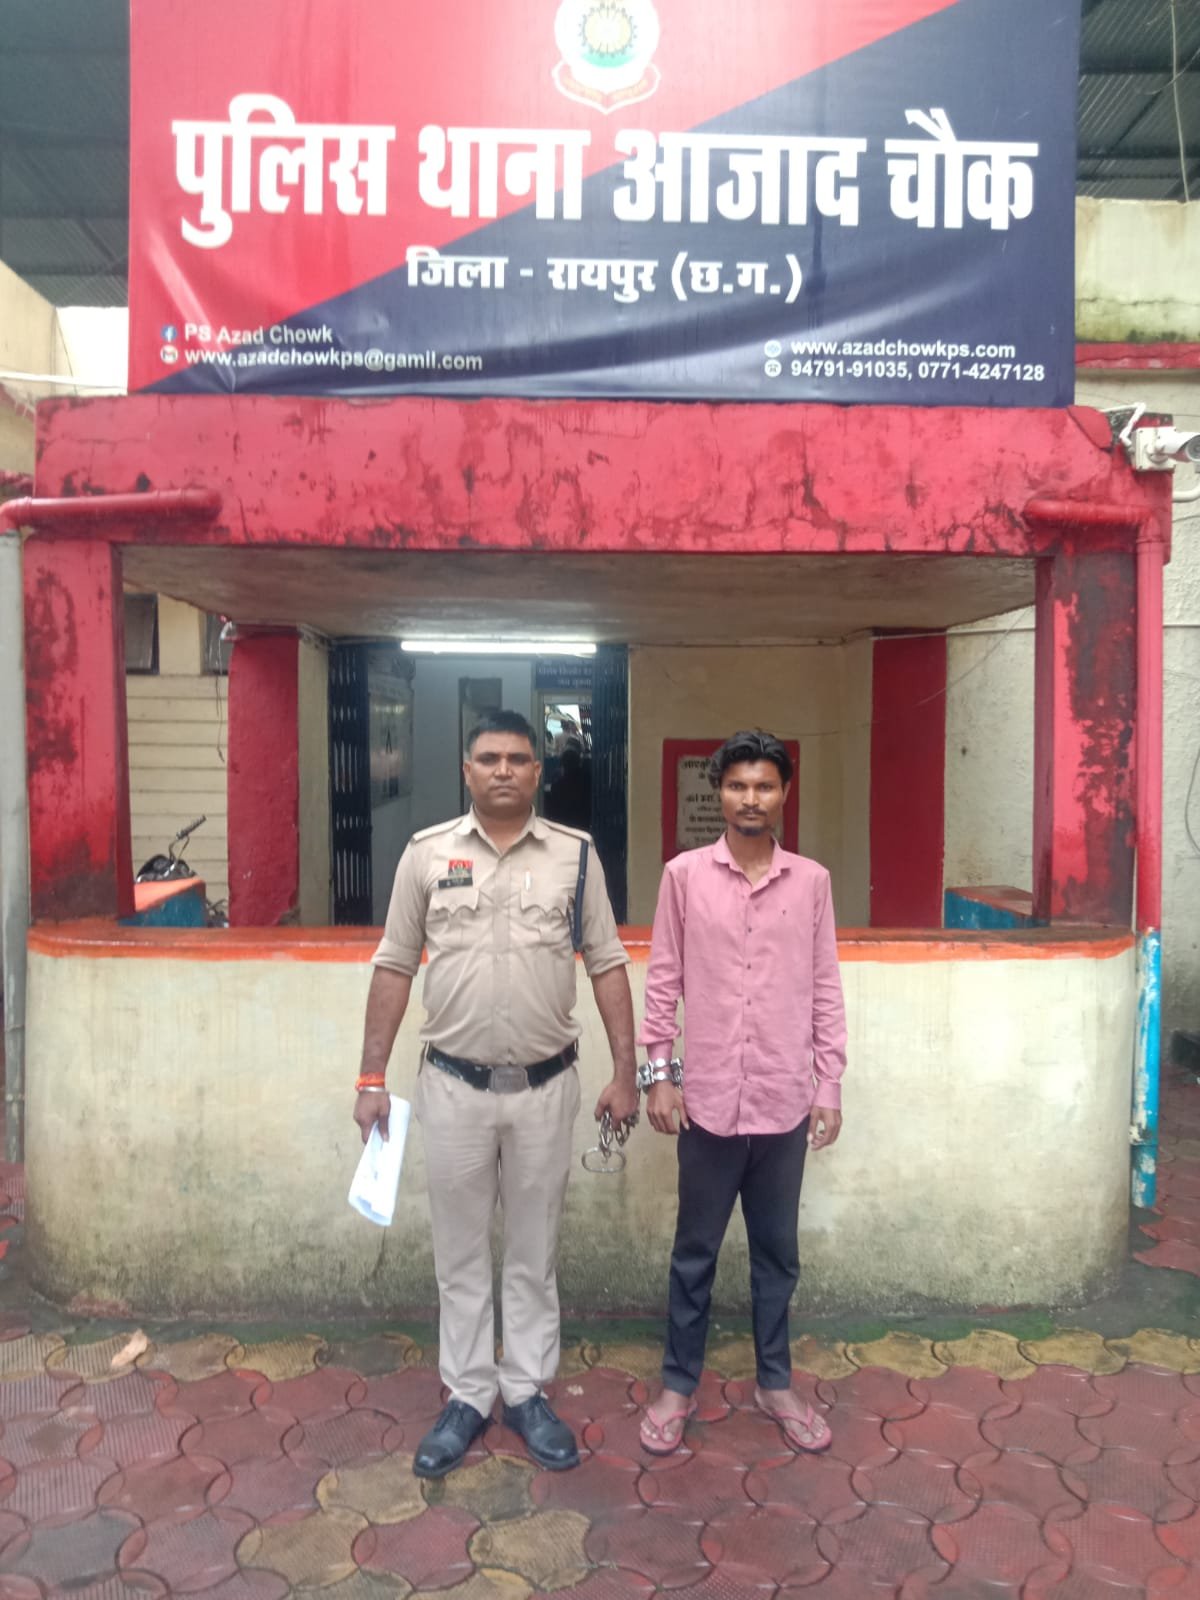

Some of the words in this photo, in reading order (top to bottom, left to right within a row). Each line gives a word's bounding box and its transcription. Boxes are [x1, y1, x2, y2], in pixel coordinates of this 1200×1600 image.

[171, 93, 396, 248] पुलिस
[418, 125, 591, 220] थाना
[613, 129, 867, 226] आजाद
[884, 108, 1039, 230] चौक
[406, 246, 508, 288] जिला
[547, 257, 658, 303] रायपुर
[185, 323, 212, 341] PS
[217, 325, 264, 344] Azad
[270, 324, 333, 345] Chowk
[791, 339, 1016, 360] www.azadchowkps.com
[791, 360, 912, 381] 94791-91035,
[918, 361, 1045, 381] 0771-4247128
